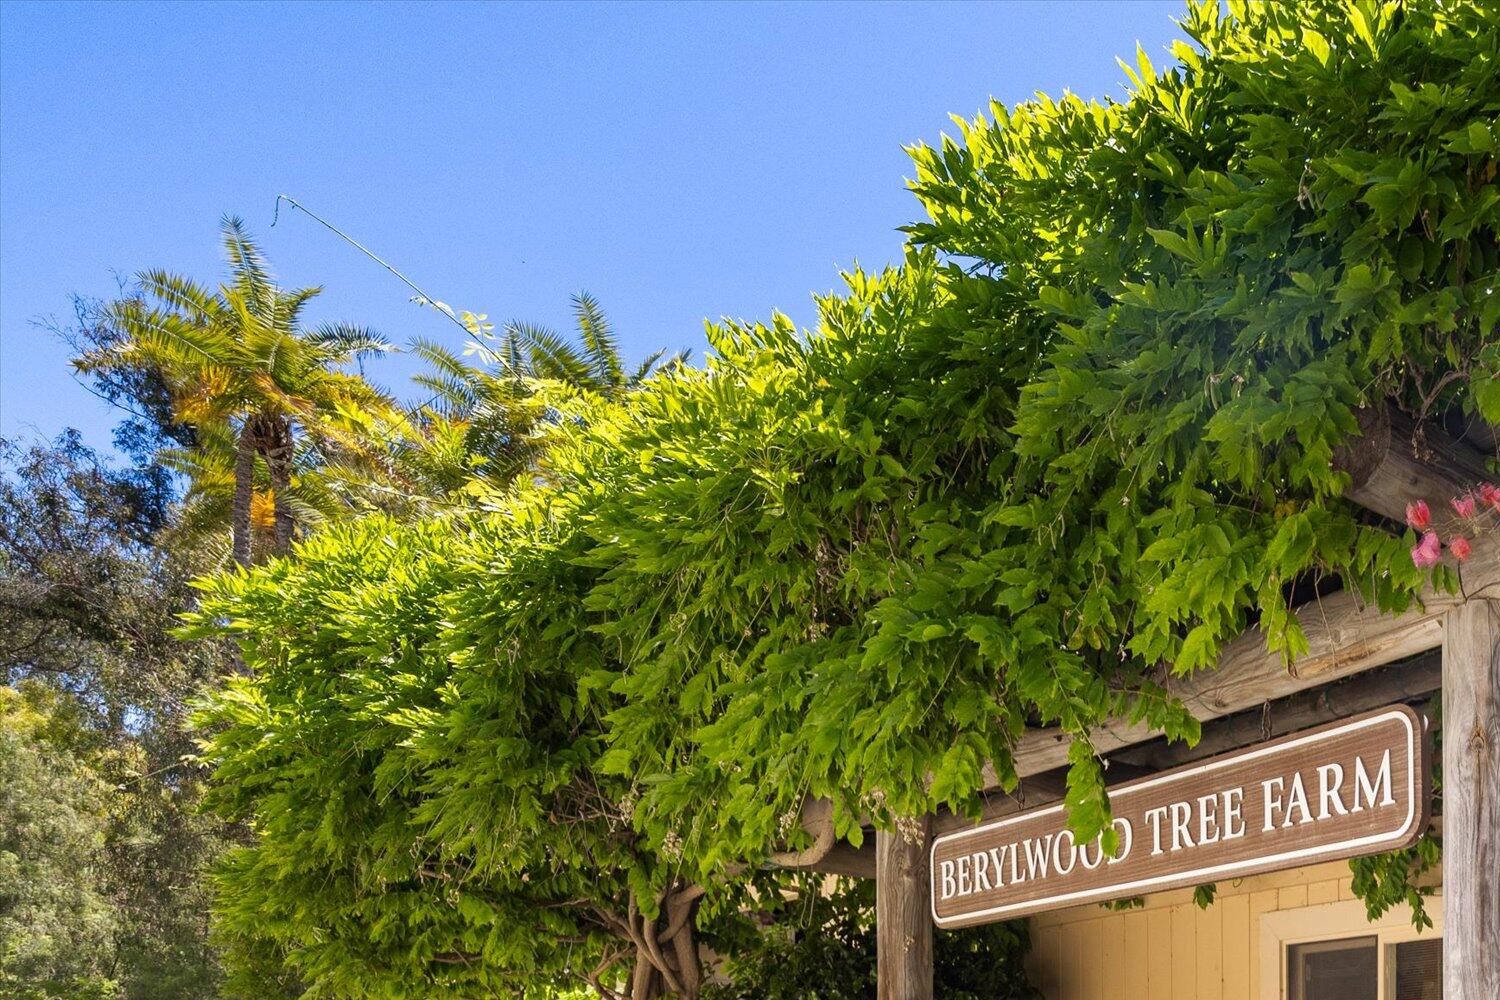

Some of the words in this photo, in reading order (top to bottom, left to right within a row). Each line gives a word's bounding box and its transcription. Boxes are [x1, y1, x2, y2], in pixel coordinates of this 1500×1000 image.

[940, 817, 1133, 900] BERYLWOOD
[1145, 786, 1246, 856] TREE
[1261, 748, 1396, 833] FARM
